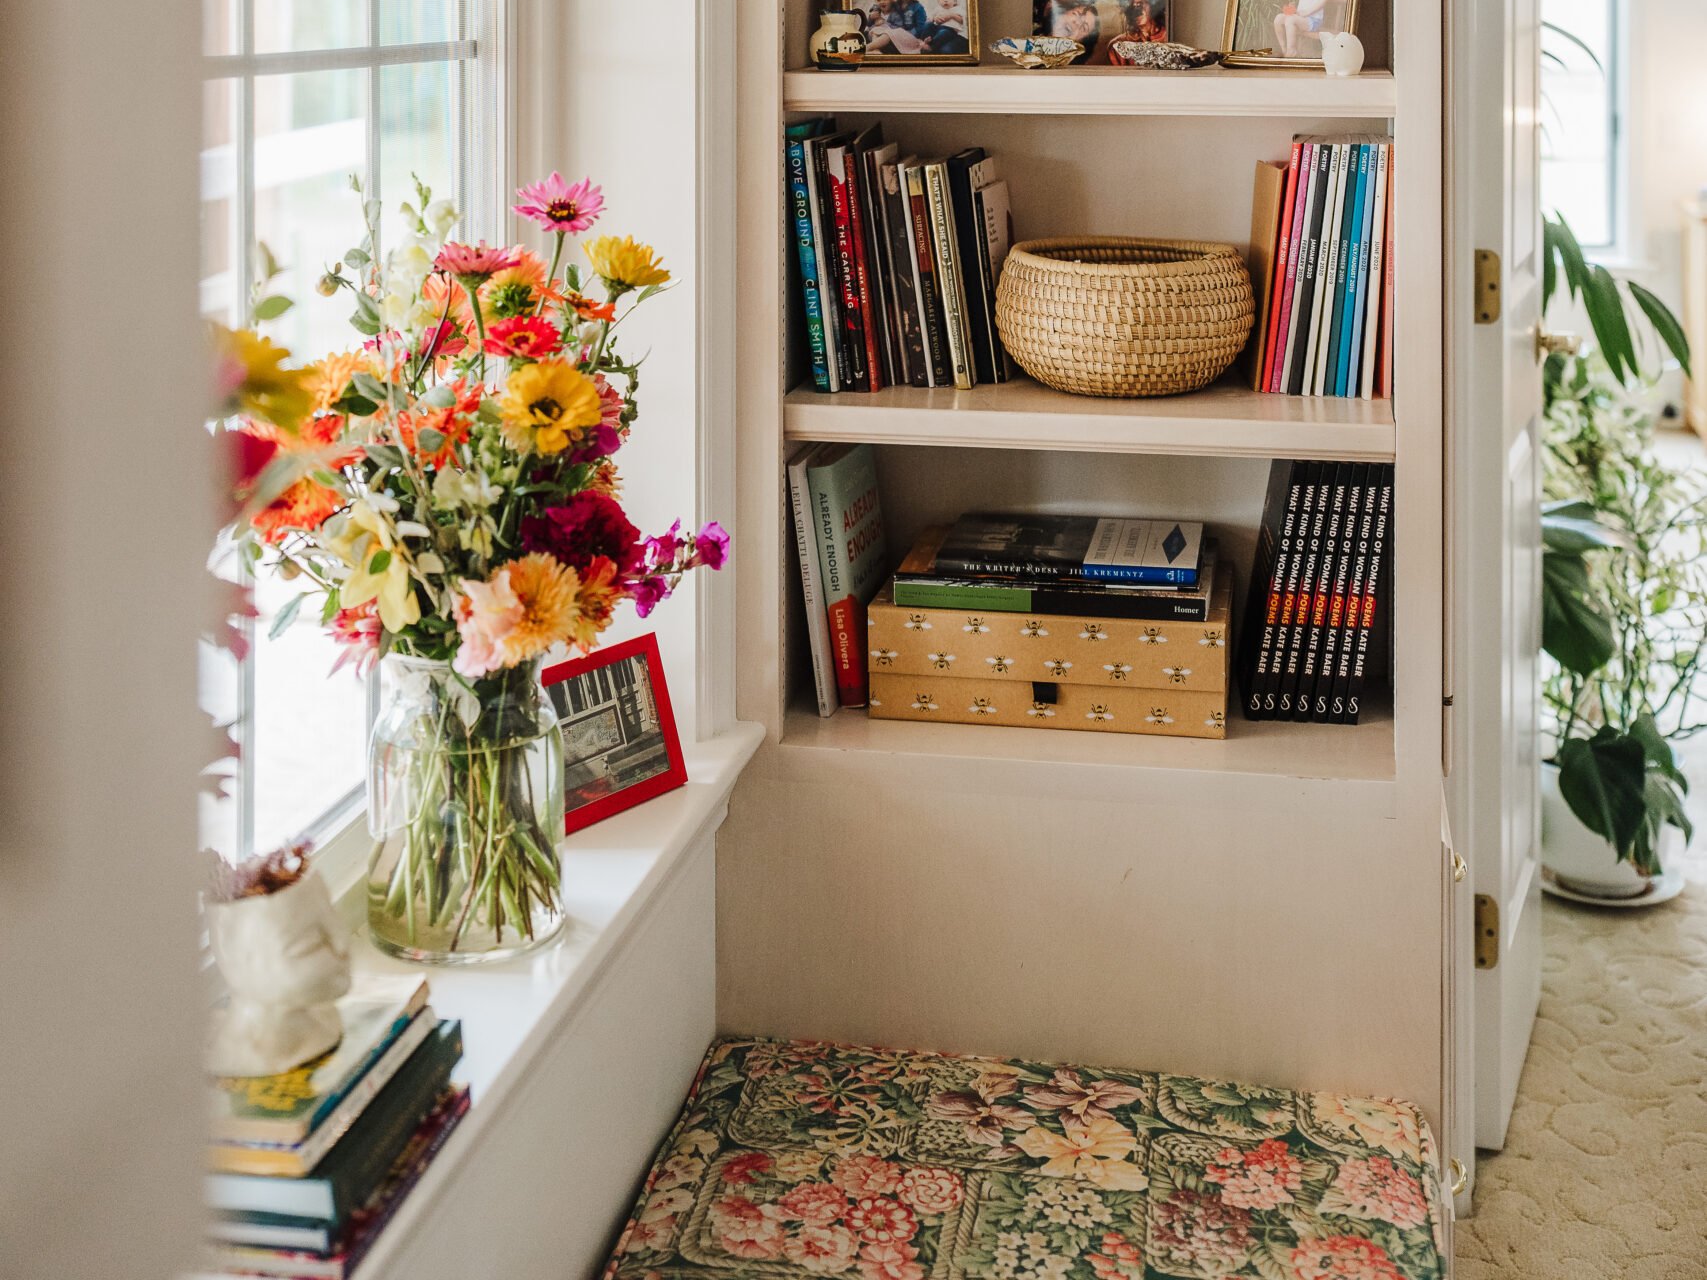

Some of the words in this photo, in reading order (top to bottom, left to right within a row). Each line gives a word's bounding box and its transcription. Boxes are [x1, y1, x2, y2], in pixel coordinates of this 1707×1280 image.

[791, 141, 803, 183] ABOVE
[932, 176, 941, 201] THAT'S
[796, 190, 810, 246] GROUND
[936, 202, 944, 224] WHAT
[838, 224, 847, 246] THE
[916, 215, 926, 253] SURFACING
[842, 252, 854, 308] CARRYING
[804, 279, 818, 317] CLINT
[925, 281, 935, 322] MARGARET
[931, 326, 940, 360] ATWOOD
[810, 324, 823, 364] SMITH
[792, 487, 804, 517] LEILA
[1304, 485, 1314, 512] WHAT
[796, 521, 807, 558] CHATTI
[1299, 514, 1309, 536] KIND
[819, 493, 833, 540] ALREADY
[826, 545, 840, 591] ENOUGH
[1296, 539, 1304, 551] OF
[986, 564, 1031, 572] WRITER'S
[1094, 570, 1144, 578] KREMENTZ
[1291, 554, 1301, 591] WOMAN
[801, 565, 813, 606] DELUGE
[835, 609, 844, 629] Lisa
[1174, 606, 1199, 614] Homer
[1284, 594, 1293, 624] POEMS
[839, 632, 849, 669] Olivera
[1277, 627, 1287, 648] KATE
[1272, 651, 1282, 673] BAER
